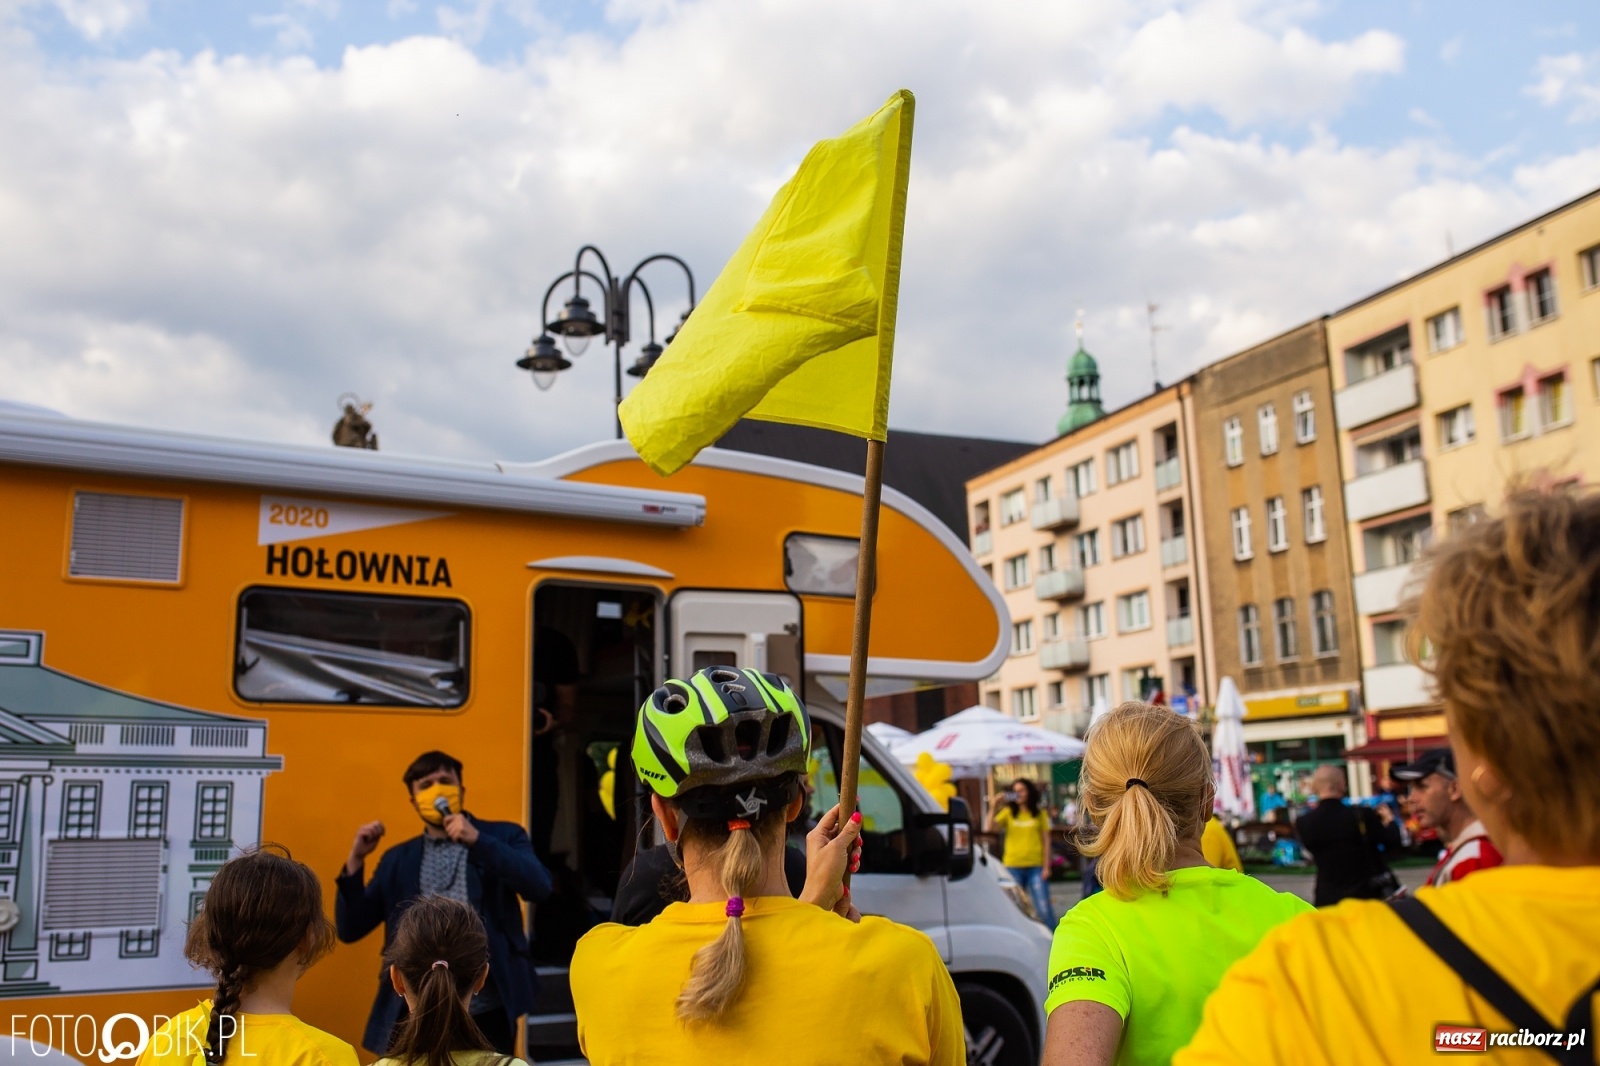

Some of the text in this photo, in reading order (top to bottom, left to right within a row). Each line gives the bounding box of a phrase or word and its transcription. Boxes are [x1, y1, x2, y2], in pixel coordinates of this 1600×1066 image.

[269, 503, 330, 529] 2020
[266, 544, 453, 588] HOŁOWNIA
[639, 766, 667, 781] SKIFF
